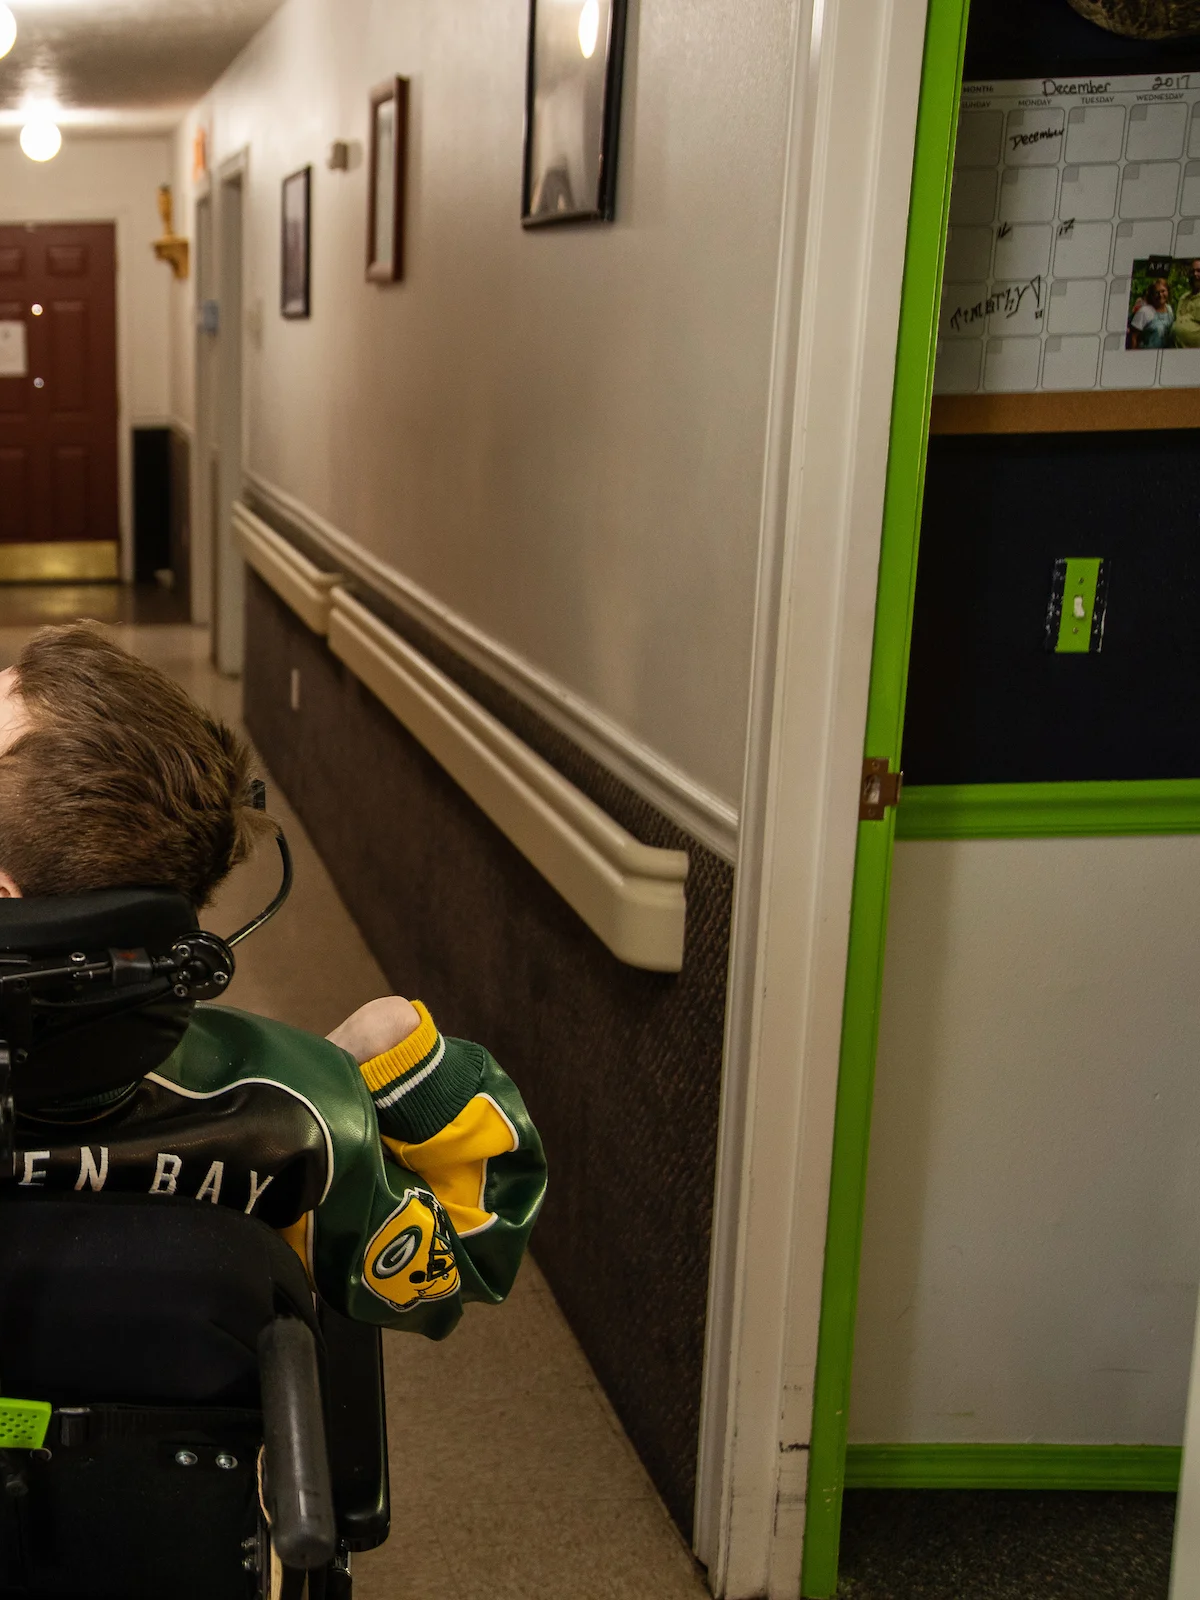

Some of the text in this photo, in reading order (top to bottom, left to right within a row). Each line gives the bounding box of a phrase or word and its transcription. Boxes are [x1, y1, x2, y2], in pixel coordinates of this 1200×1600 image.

[1042, 74, 1191, 97] December 2017
[1017, 98, 1052, 107] MONDAY
[1080, 96, 1115, 105] TUESDAY
[1136, 93, 1185, 102] WEDNESDAY
[1008, 127, 1065, 151] December
[148, 1152, 274, 1215] BAY
